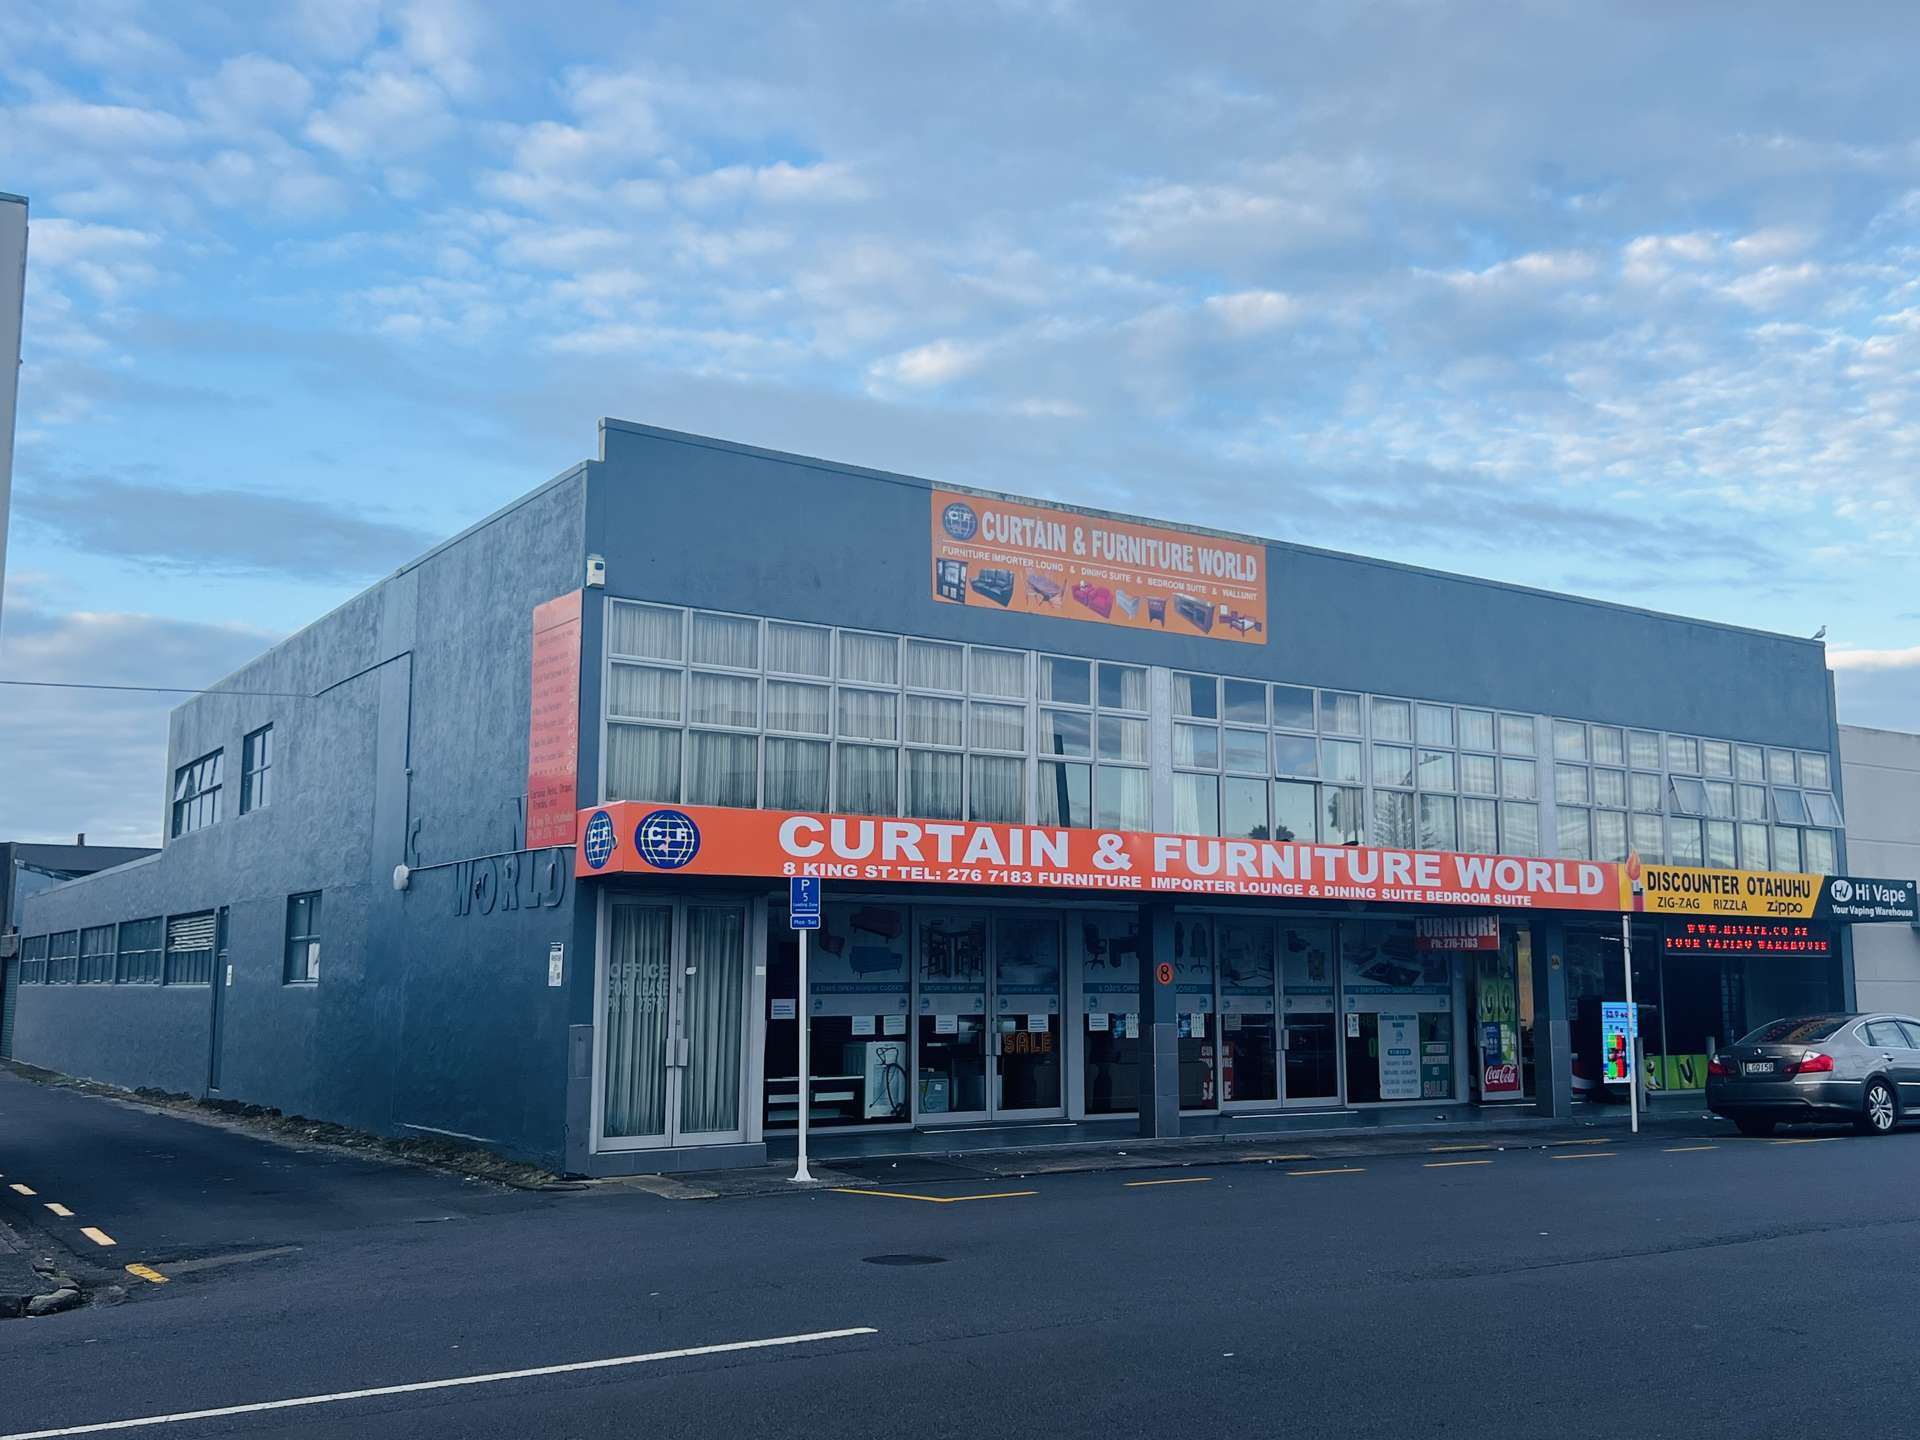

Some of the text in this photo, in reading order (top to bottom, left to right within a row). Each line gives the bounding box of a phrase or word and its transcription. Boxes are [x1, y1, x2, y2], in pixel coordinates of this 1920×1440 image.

[981, 511, 1257, 582] CURTAIN & FURNITURE WORLD
[942, 546, 991, 561] FURNITURE
[991, 553, 1034, 568] IMPORTER
[1069, 565, 1076, 574] &
[1081, 567, 1108, 578] DINING
[1109, 572, 1132, 583] SUITE
[1148, 577, 1185, 591] BEDROOM
[1186, 583, 1207, 593] SUITE
[778, 816, 1605, 895] CURTAIN & FURNITURE WORLD
[454, 849, 566, 917] WORLD
[783, 862, 1532, 906] 8 KING ST TEL: 276 7183 FURNITURE IMPORTER LOUNGE & DINING SUITE BEDROOM SUITE
[801, 879, 810, 891] P
[1647, 870, 1811, 898] DISCOUNTER OTAHUHU
[802, 892, 809, 902] 5
[1657, 896, 1700, 909] ZIG-ZAG
[1713, 900, 1748, 911] RIZZLA
[1855, 883, 1870, 901] Hi
[1872, 884, 1906, 906] Vape
[1831, 904, 1913, 917] Your Vaping Warehouse
[1415, 915, 1497, 937] FURNITURE
[610, 963, 669, 978] OFFICE
[1161, 965, 1169, 982] 8
[609, 980, 669, 996] FOR LEASE
[1004, 1032, 1052, 1054] SALE
